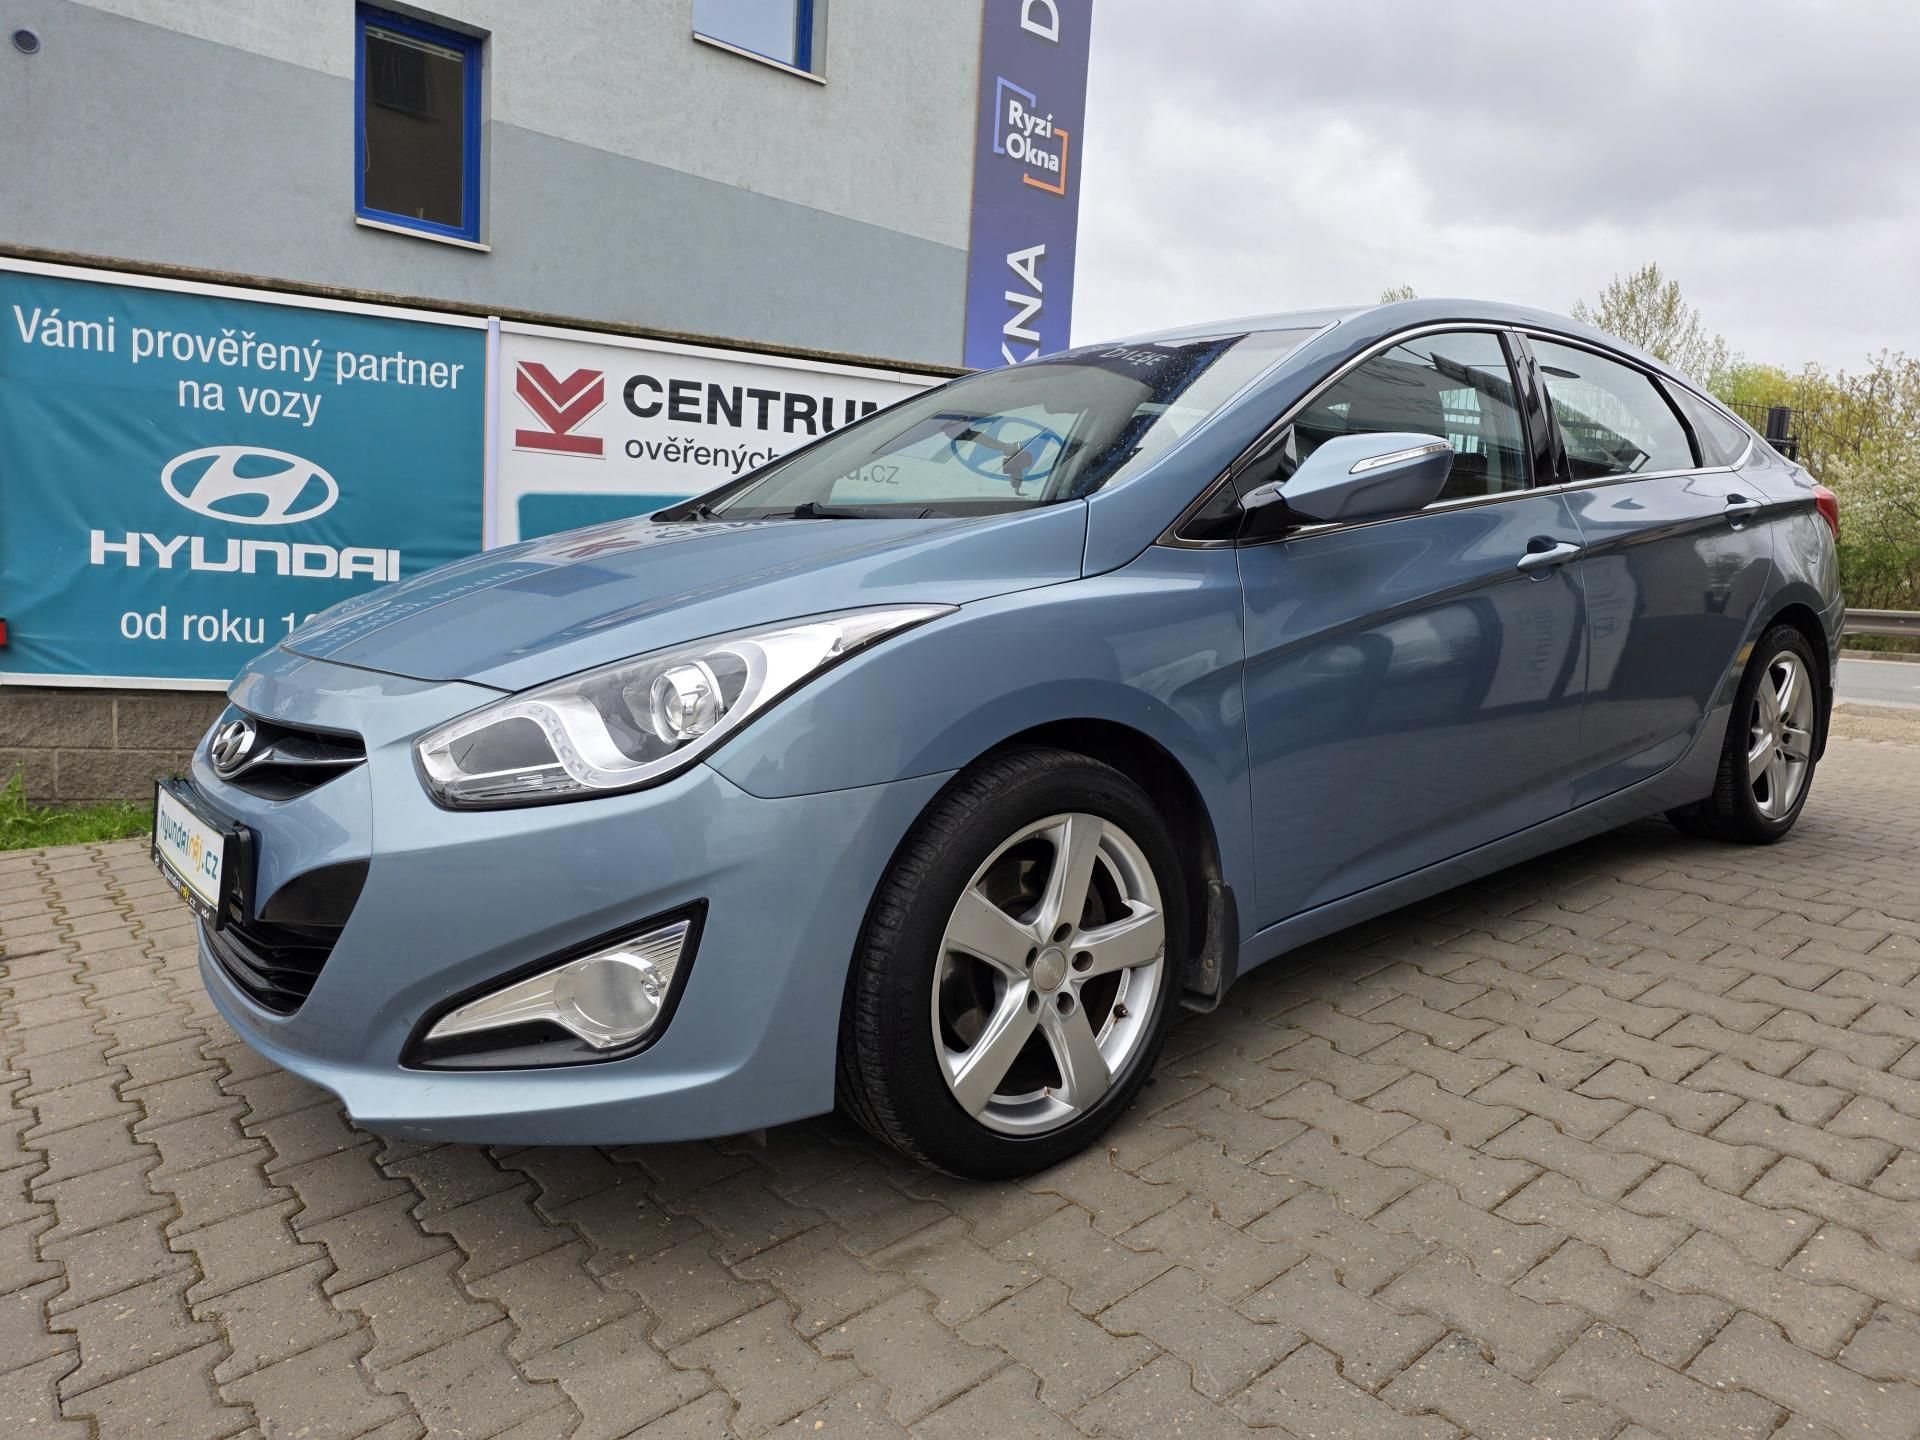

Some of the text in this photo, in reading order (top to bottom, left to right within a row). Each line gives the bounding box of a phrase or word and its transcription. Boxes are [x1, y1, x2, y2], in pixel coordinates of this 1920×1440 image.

[1009, 100, 1053, 139] Ryzí
[1006, 133, 1059, 173] Okna
[13, 305, 465, 390] Vámi prověřený partner
[178, 379, 322, 427] na vozy
[90, 529, 400, 582] HYUNDAI
[120, 606, 167, 641] od
[183, 608, 265, 644] roku
[281, 612, 317, 634] 1
